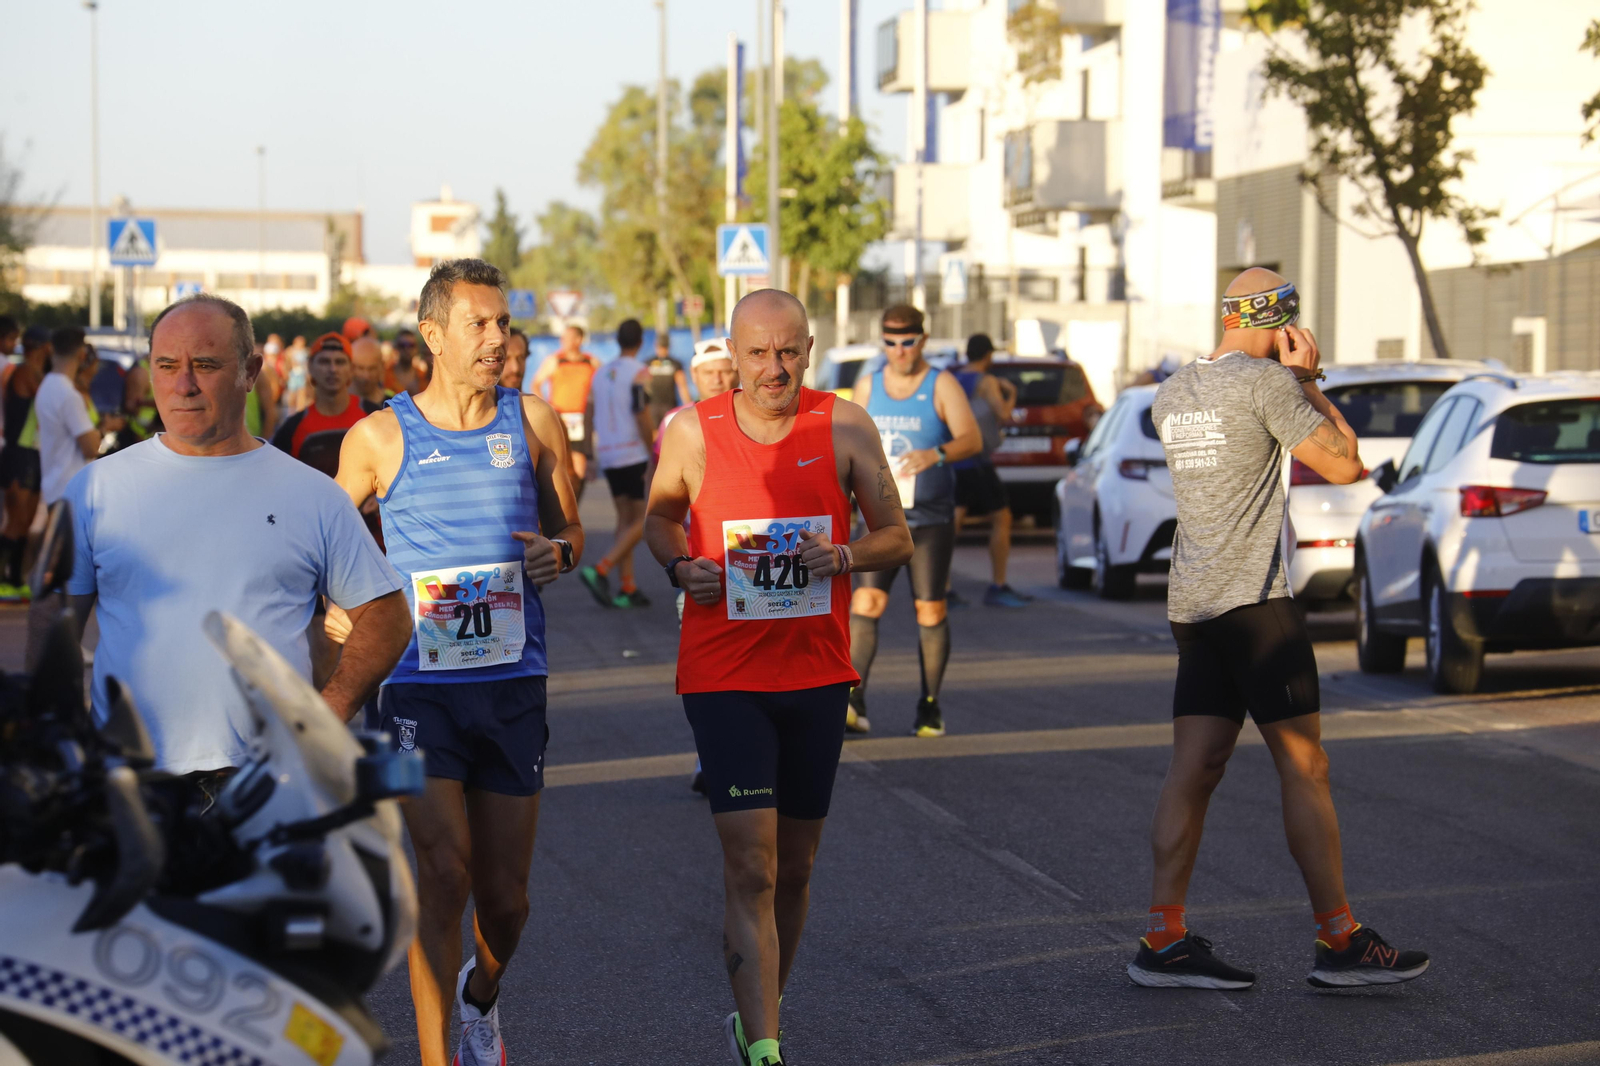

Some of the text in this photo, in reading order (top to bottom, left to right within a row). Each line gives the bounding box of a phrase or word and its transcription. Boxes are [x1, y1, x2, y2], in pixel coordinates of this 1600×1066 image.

[1171, 410, 1222, 425] MORAL
[418, 456, 451, 465] MERCURY
[491, 458, 515, 468] BAIONA
[753, 554, 809, 590] 426
[454, 602, 492, 640] 20
[743, 787, 773, 796] Running
[93, 924, 284, 1050] 092
